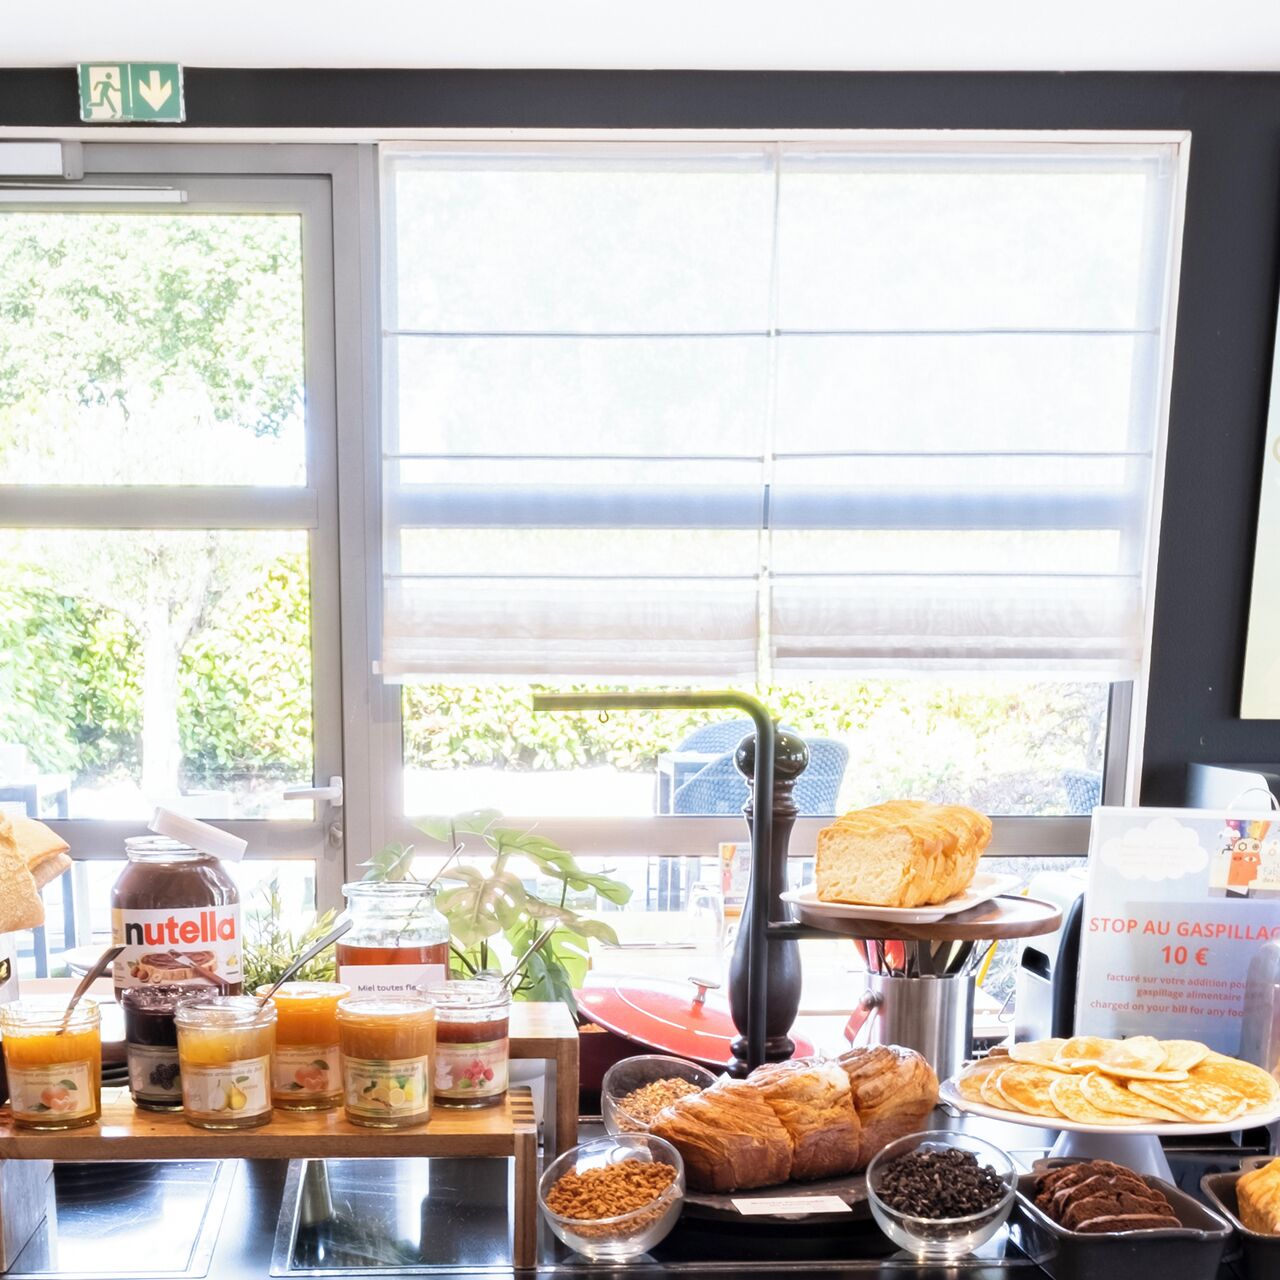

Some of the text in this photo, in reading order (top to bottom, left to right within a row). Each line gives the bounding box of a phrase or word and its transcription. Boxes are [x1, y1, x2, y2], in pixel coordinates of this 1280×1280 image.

[125, 911, 236, 945] nutella
[1089, 917, 1138, 934] STOP
[1143, 920, 1170, 936] AU
[1161, 946, 1209, 966] 10 €
[358, 984, 375, 992] Miel
[1107, 973, 1140, 984] facturé
[1142, 976, 1157, 984] sur
[1160, 976, 1185, 986] votre
[1187, 977, 1227, 989] addition
[1136, 987, 1241, 1001] gaspillage alimentaire
[1090, 999, 1130, 1012] charged
[1132, 1003, 1144, 1011] on
[1146, 1004, 1170, 1014] your
[1172, 1002, 1187, 1013] bill
[1190, 1004, 1205, 1015] for
[1207, 1008, 1225, 1018] any
